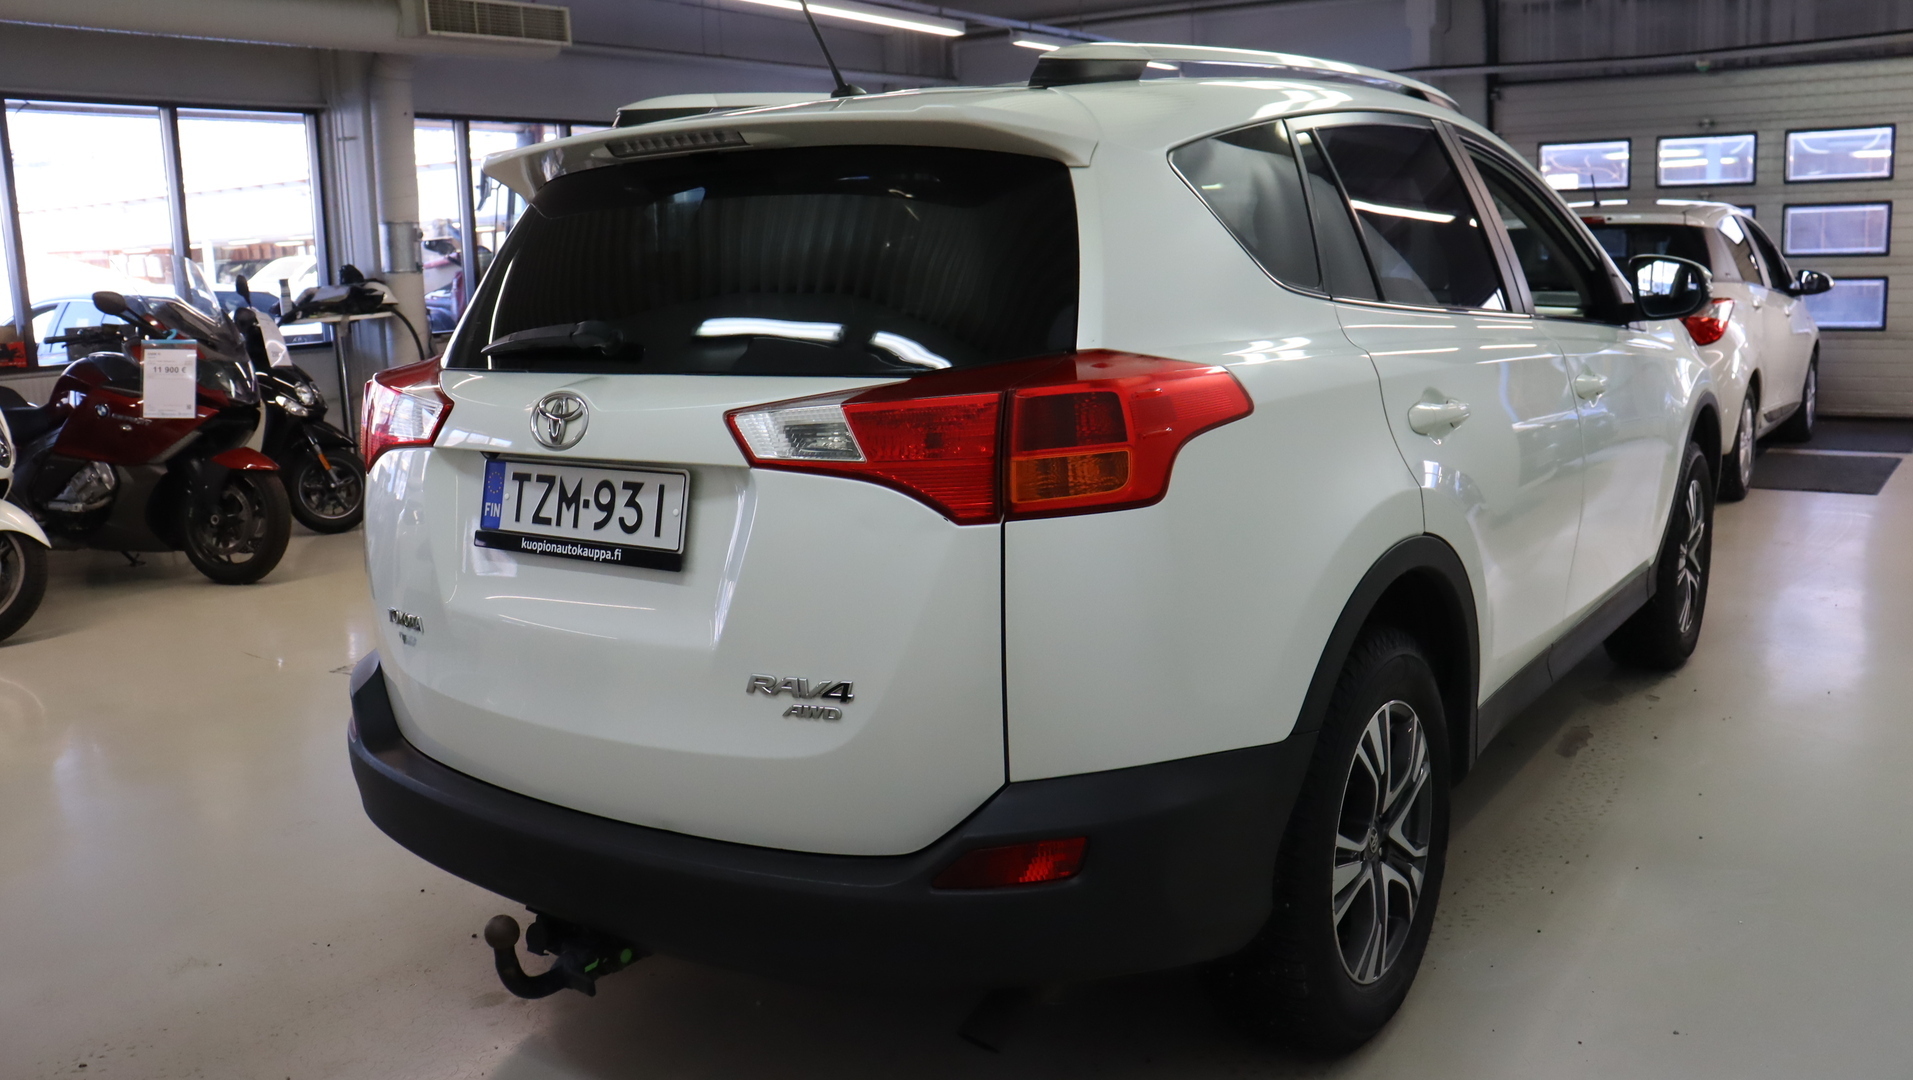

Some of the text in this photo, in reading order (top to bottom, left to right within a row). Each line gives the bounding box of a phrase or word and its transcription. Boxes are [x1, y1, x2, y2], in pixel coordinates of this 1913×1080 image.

[484, 502, 500, 517] FIN
[511, 472, 665, 537] TZM-931
[521, 538, 622, 562] kuopionautokauppa.fi
[746, 673, 855, 704] RAV4
[782, 704, 843, 720] AWD
